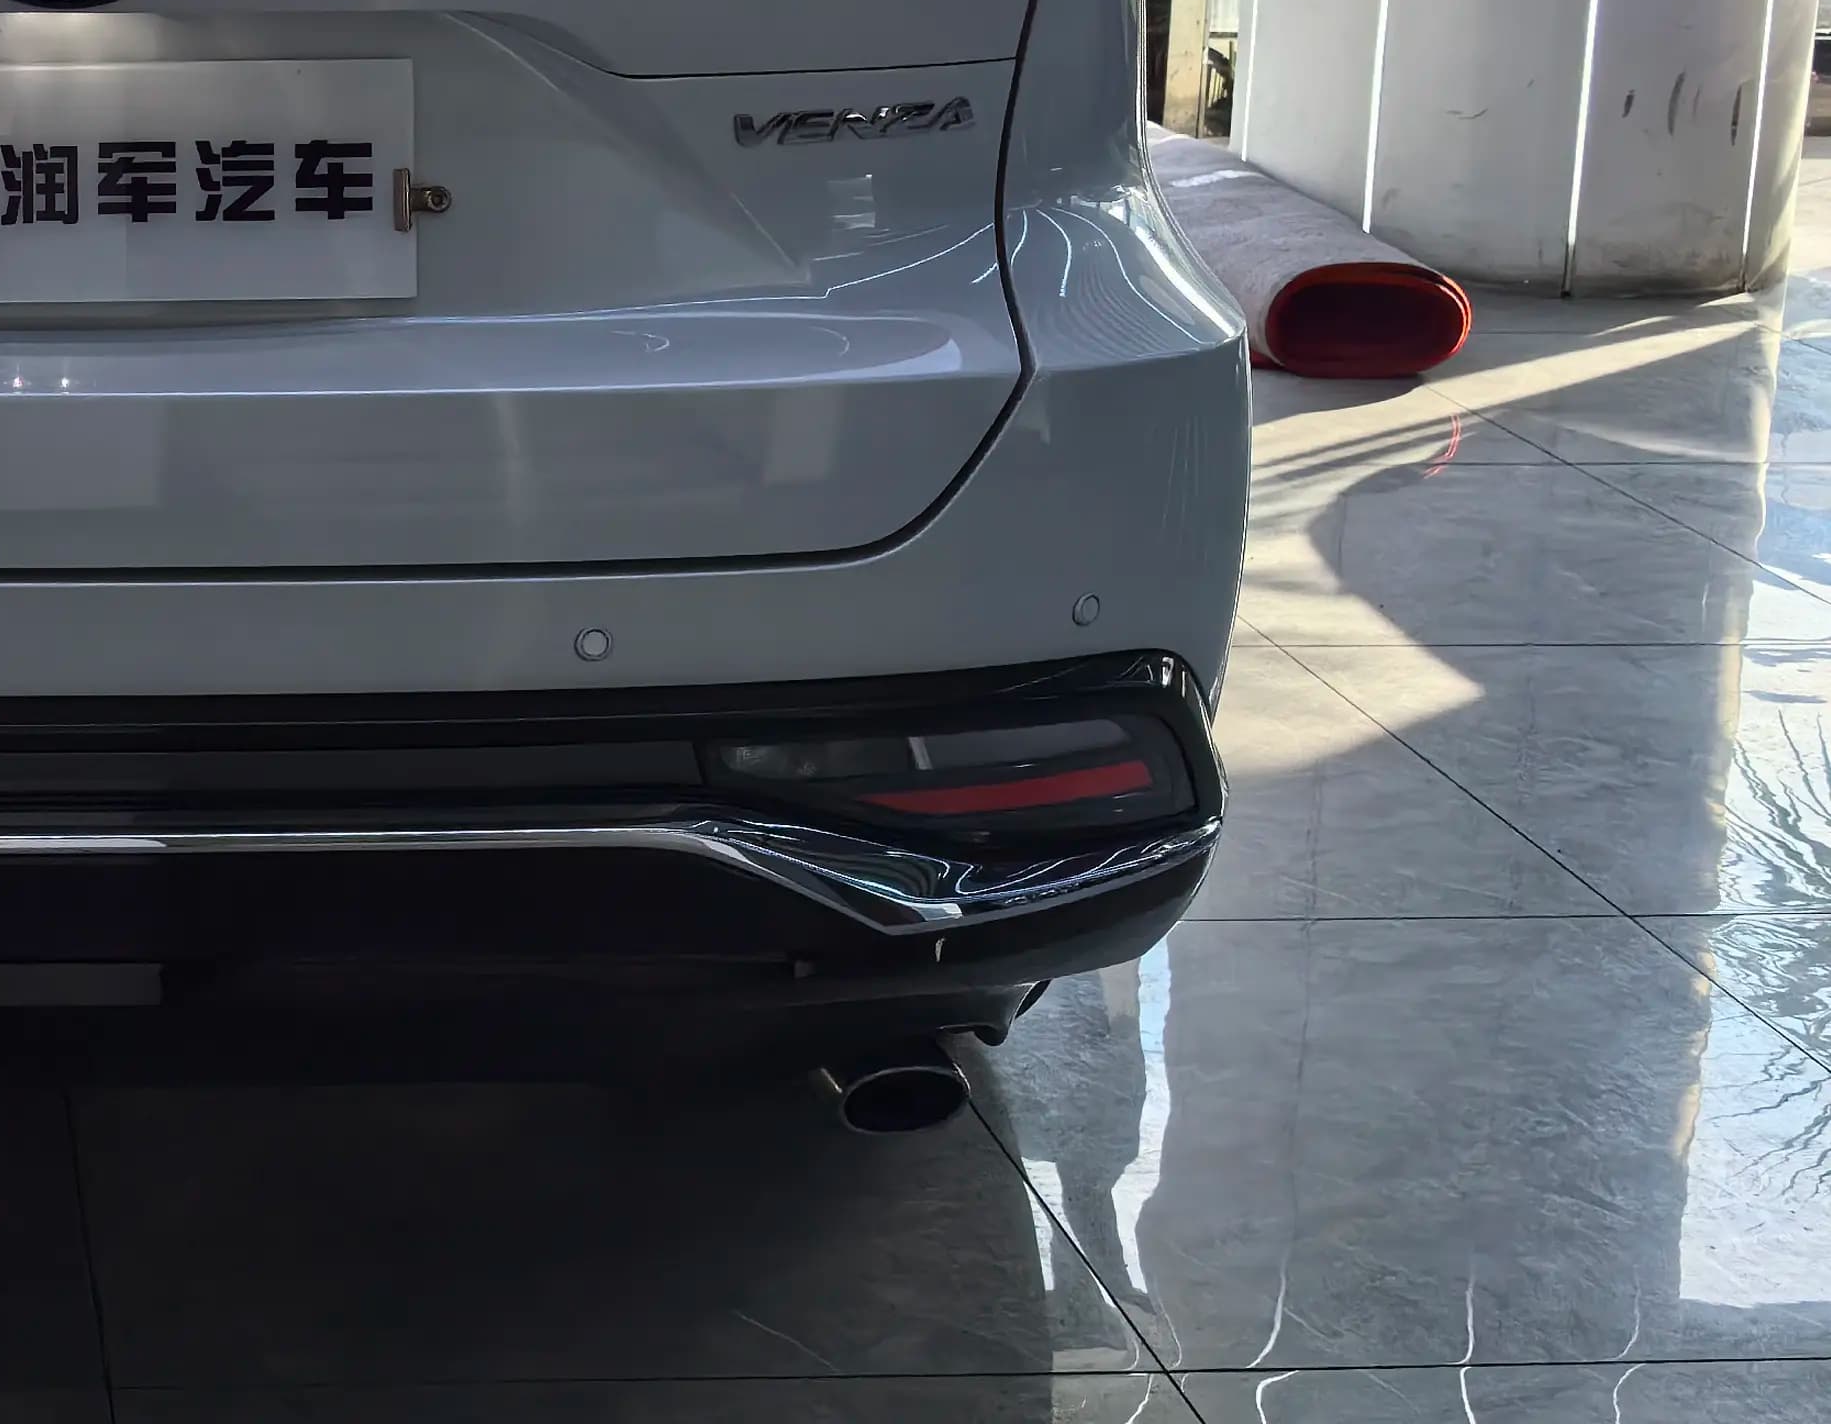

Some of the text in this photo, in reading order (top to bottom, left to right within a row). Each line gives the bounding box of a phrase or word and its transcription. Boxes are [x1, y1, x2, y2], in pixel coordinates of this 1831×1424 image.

[733, 96, 976, 147] VENZA
[0, 138, 375, 226] 润军汽车
